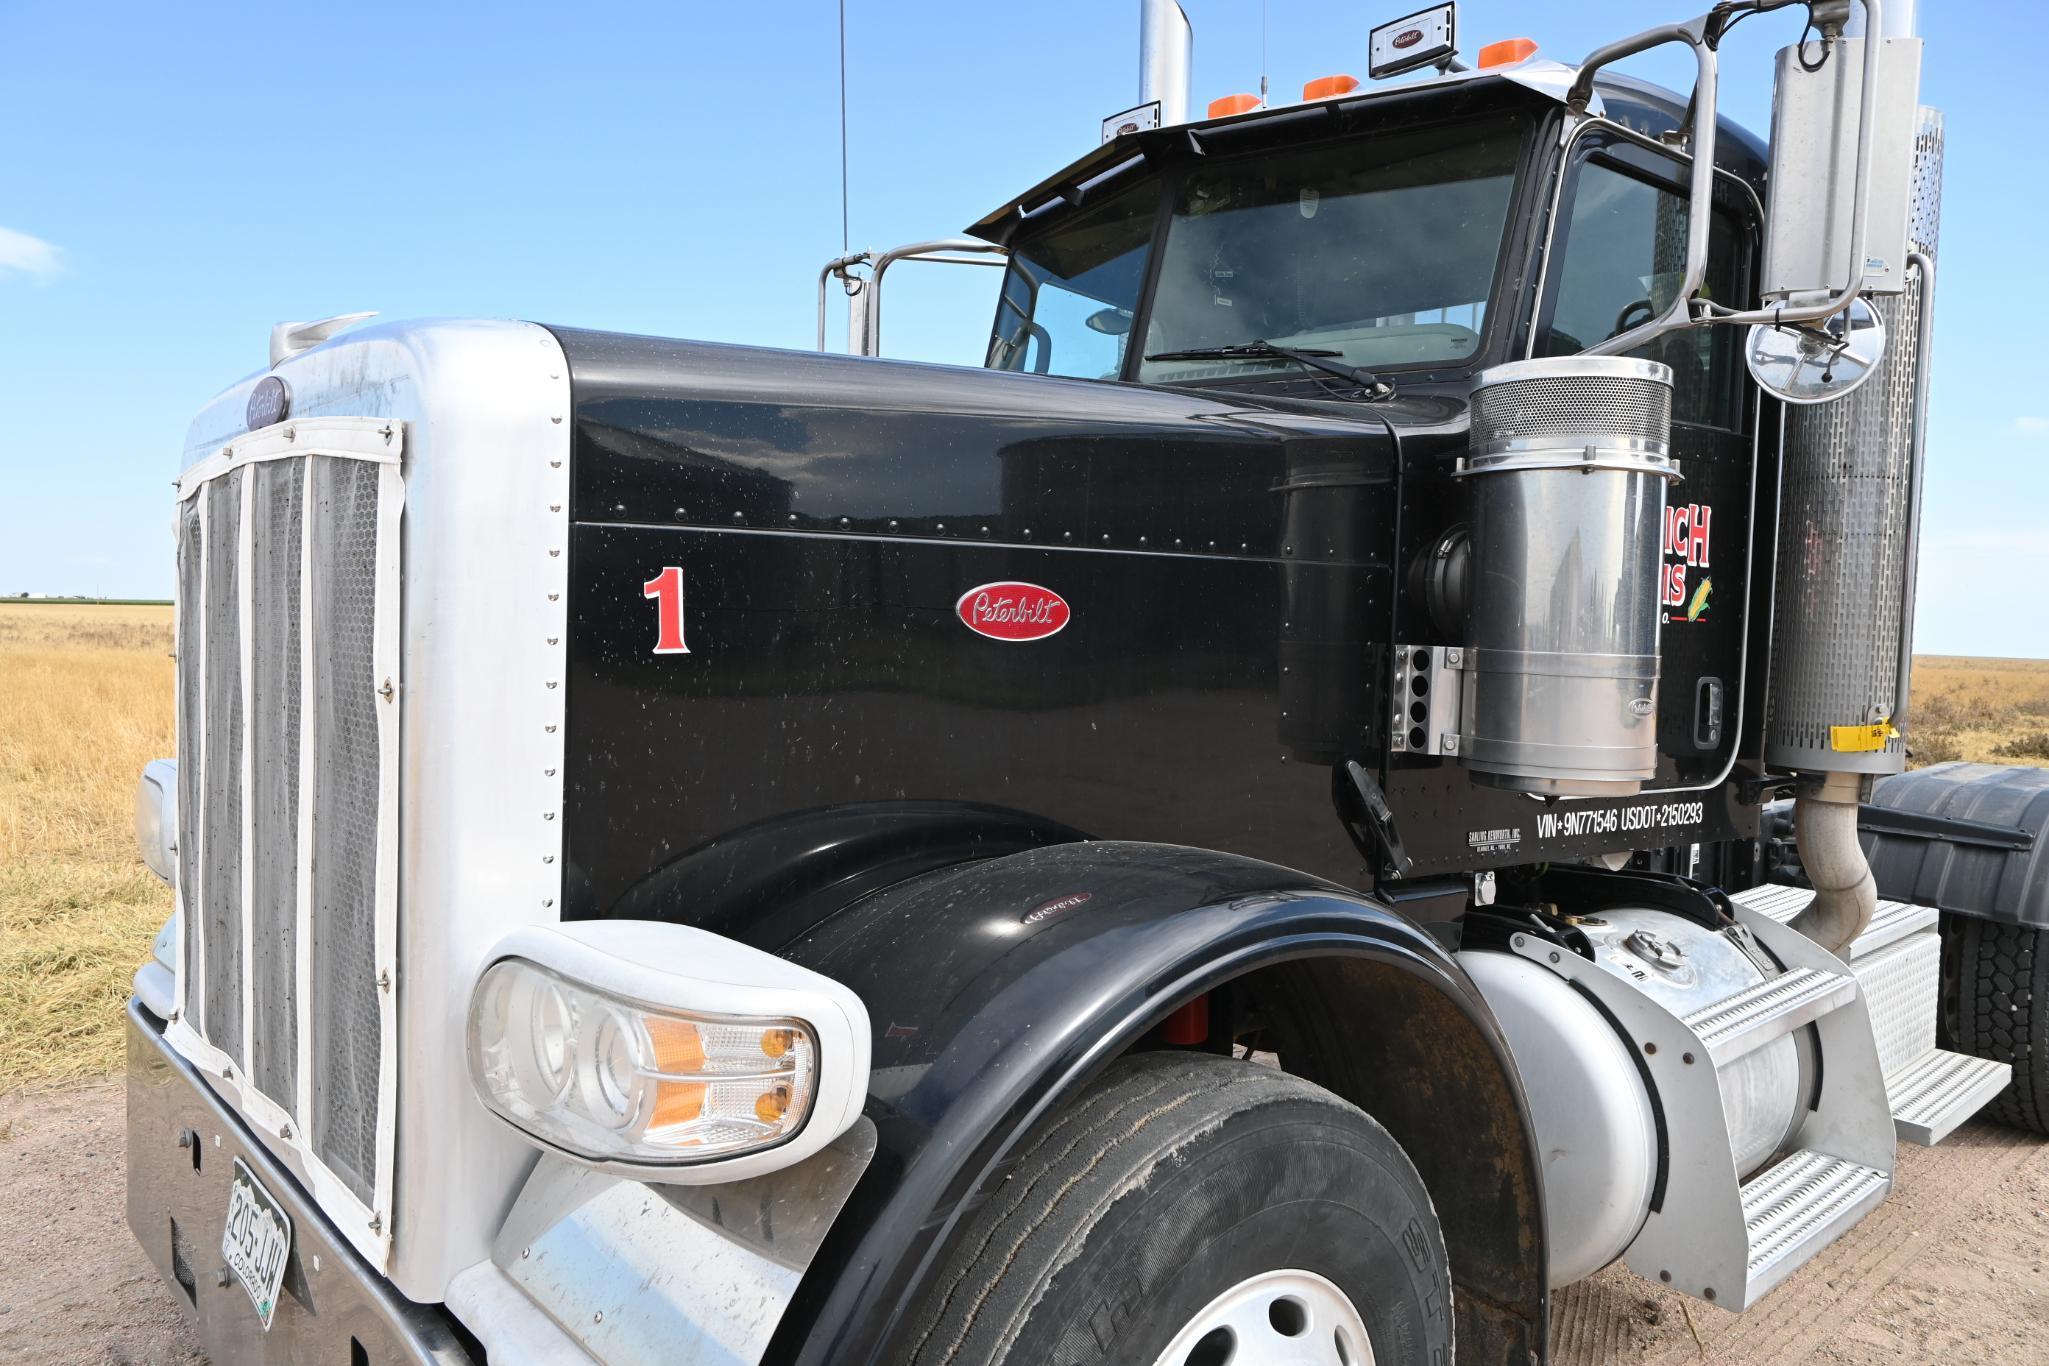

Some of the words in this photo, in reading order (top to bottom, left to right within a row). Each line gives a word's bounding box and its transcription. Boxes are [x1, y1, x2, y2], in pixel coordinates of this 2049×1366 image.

[643, 566, 691, 654] 1
[971, 592, 1060, 625] Peterbilt
[233, 1252, 262, 1299] COLORADO
